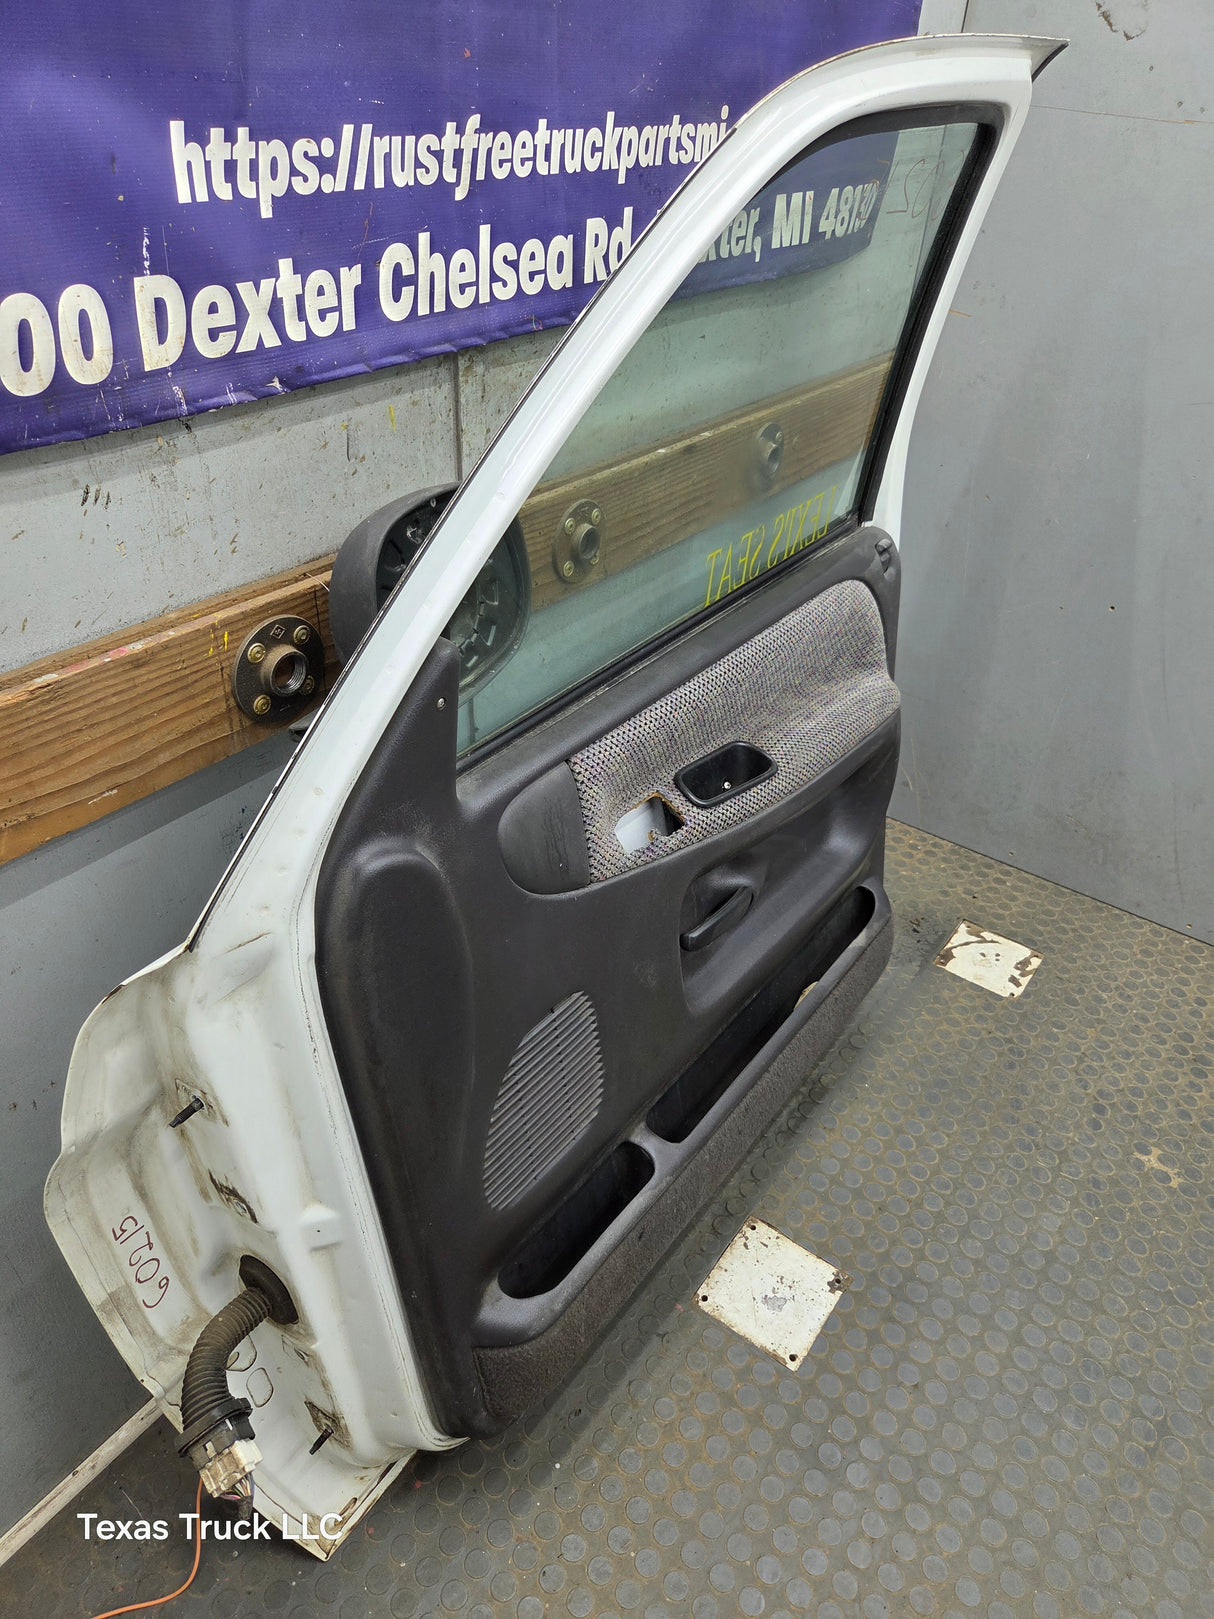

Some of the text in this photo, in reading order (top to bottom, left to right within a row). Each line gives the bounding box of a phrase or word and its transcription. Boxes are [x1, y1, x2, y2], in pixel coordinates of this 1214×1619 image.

[133, 257, 363, 372] Dexter
[379, 223, 574, 322] Chelsea
[771, 190, 815, 249] MI
[111, 1215, 170, 1309] 60215
